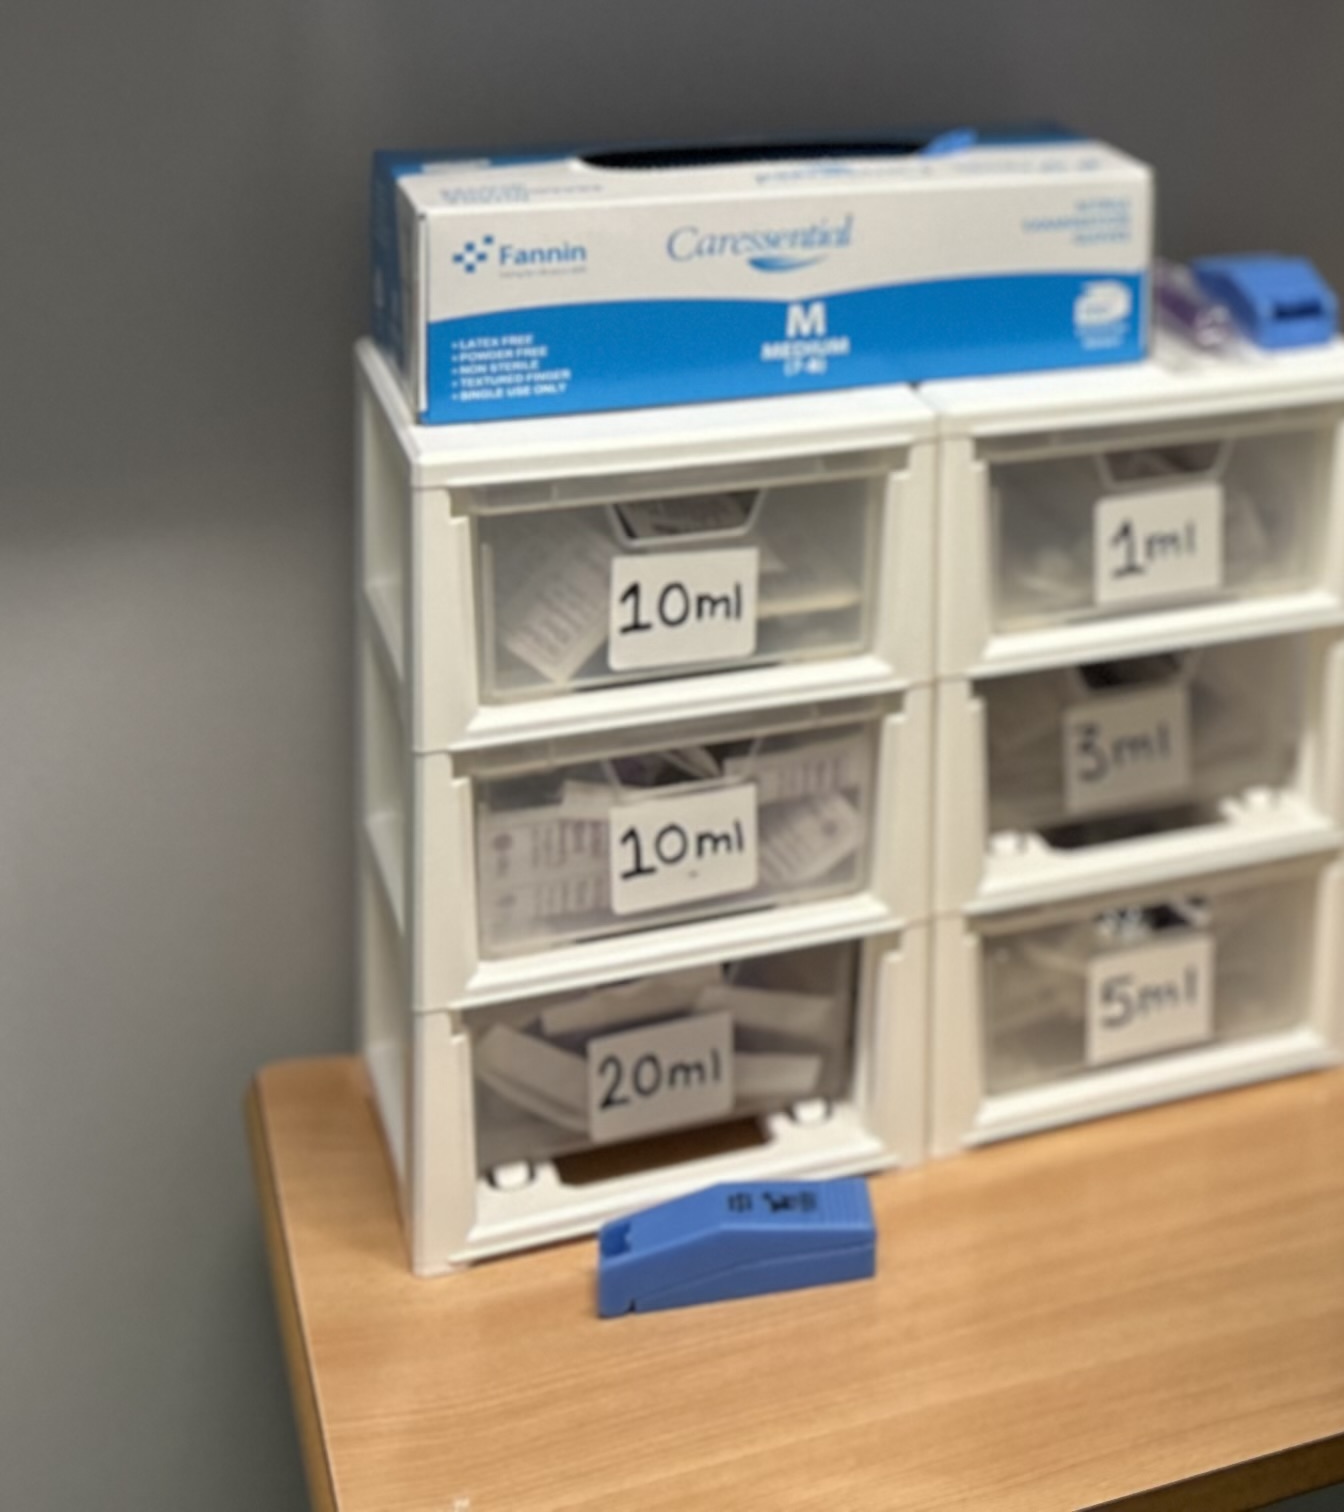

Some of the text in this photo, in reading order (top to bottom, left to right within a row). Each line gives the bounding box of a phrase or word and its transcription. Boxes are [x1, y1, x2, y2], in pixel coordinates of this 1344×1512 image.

[499, 243, 587, 265] Fannin
[667, 212, 855, 262] Caressential
[786, 301, 827, 338] M
[760, 337, 850, 360] MEDIUM
[1109, 519, 1197, 579] 1ml
[620, 580, 742, 635] 10ml
[1078, 722, 1170, 782] 3ml
[620, 817, 744, 879] 10ml
[1100, 963, 1197, 1028] 5ml
[599, 1048, 721, 1110] 20ml
